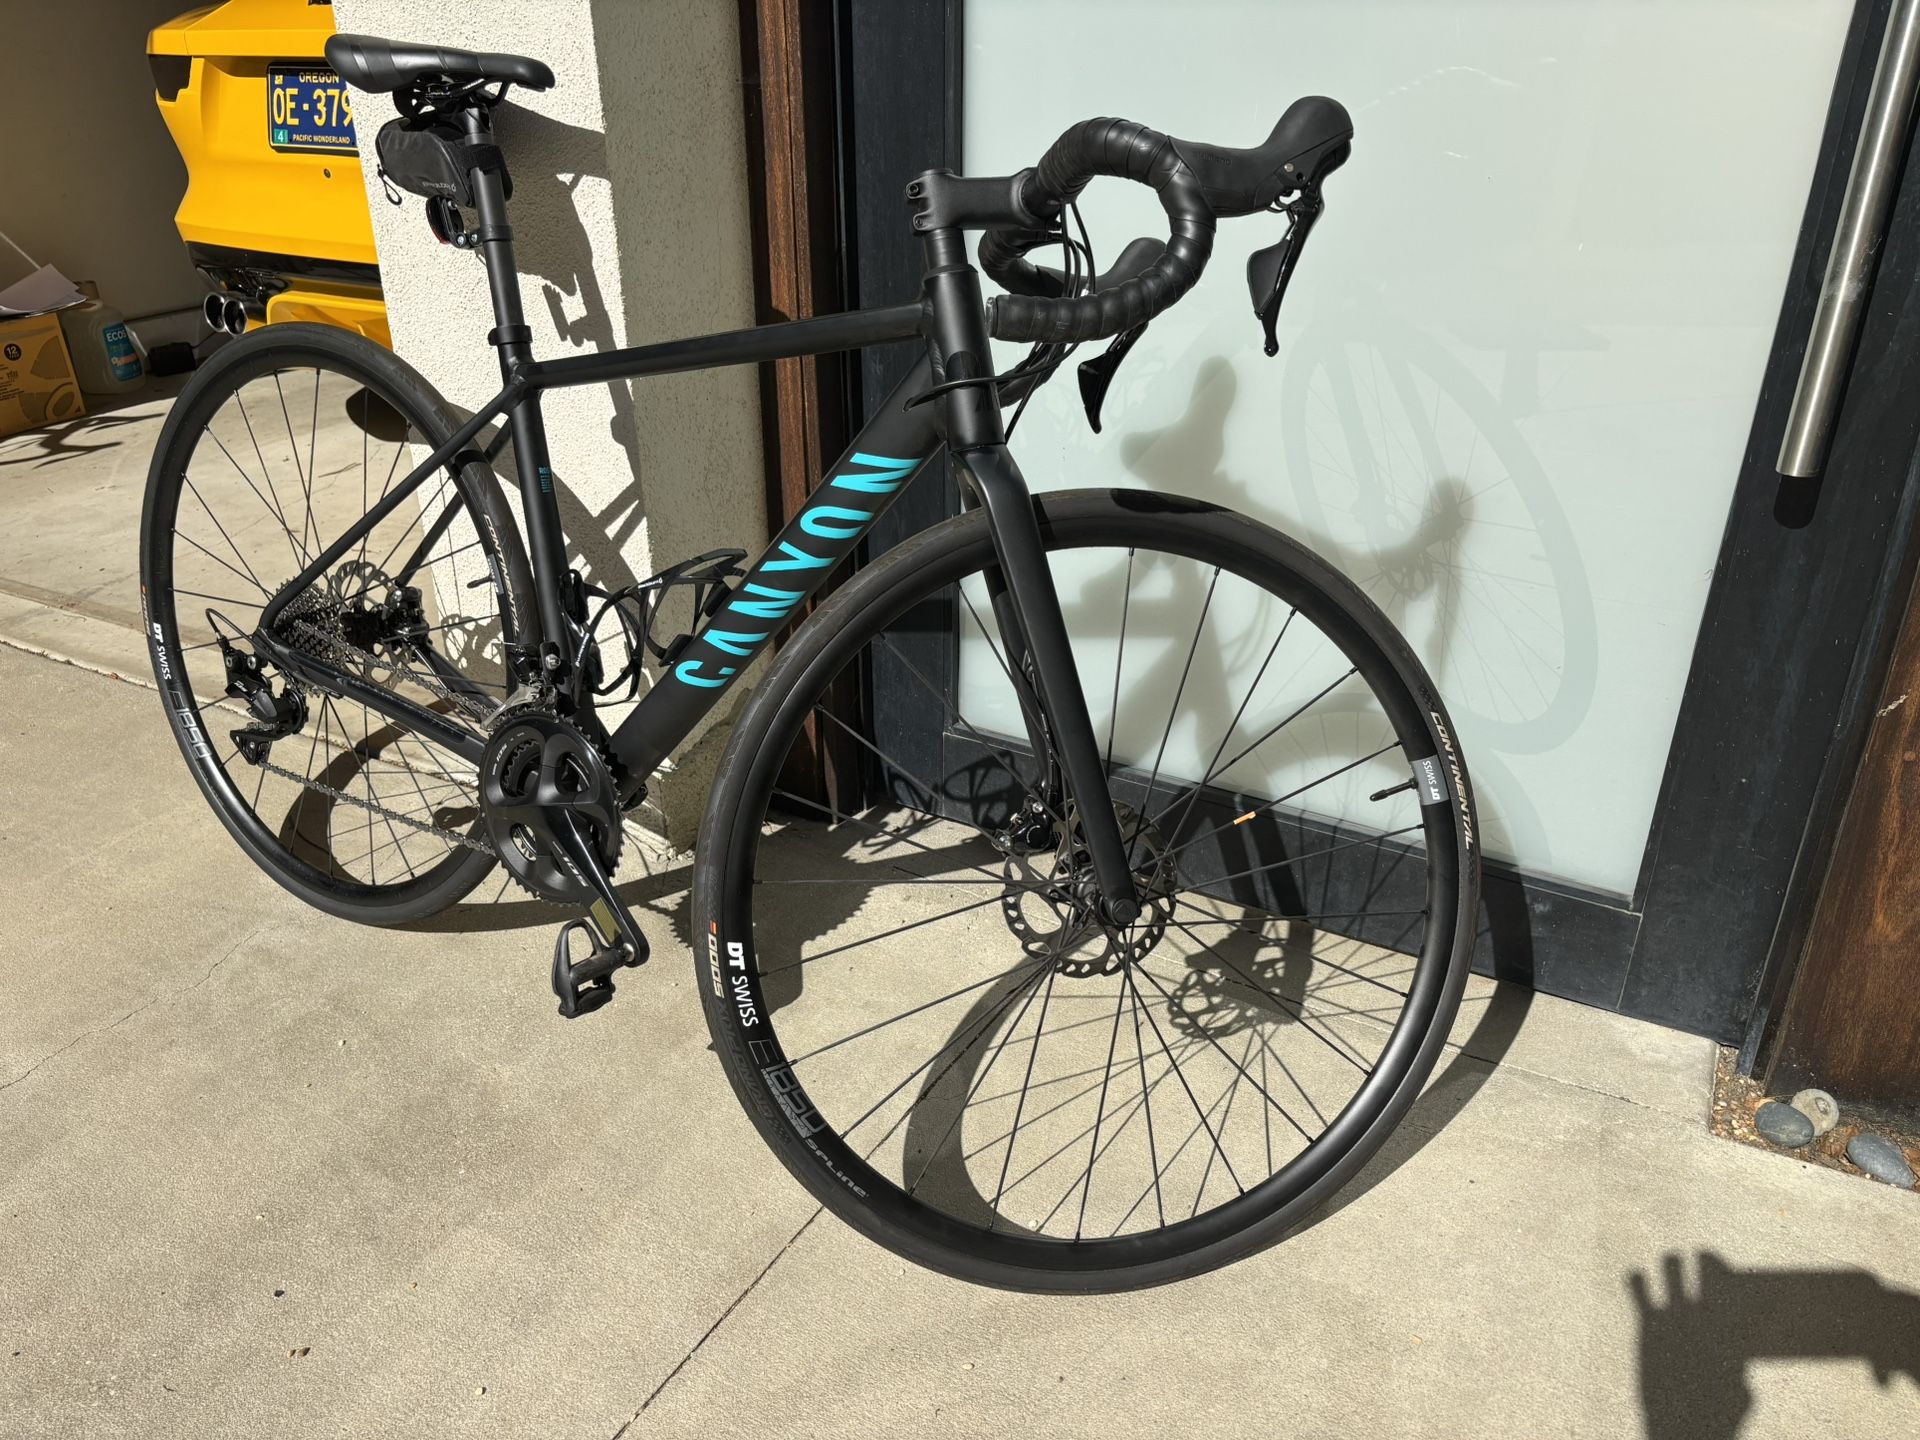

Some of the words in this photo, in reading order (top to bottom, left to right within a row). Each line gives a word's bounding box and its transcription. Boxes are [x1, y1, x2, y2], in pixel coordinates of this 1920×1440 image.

[299, 72, 339, 83] OREGON
[292, 133, 312, 142] PACIFIC
[313, 134, 351, 144] WONDERLAND
[484, 513, 520, 636] CONTINENTAL
[675, 452, 924, 688] CANYON
[153, 622, 164, 643] DT
[157, 645, 172, 680] SWISS
[1422, 760, 1437, 785] SWISS
[1430, 711, 1474, 850] CONTINENTAL
[1430, 786, 1440, 800] DT
[562, 855, 589, 888] 105
[707, 933, 725, 998] 5000
[727, 942, 746, 971] DT
[732, 975, 759, 1027] SWISS
